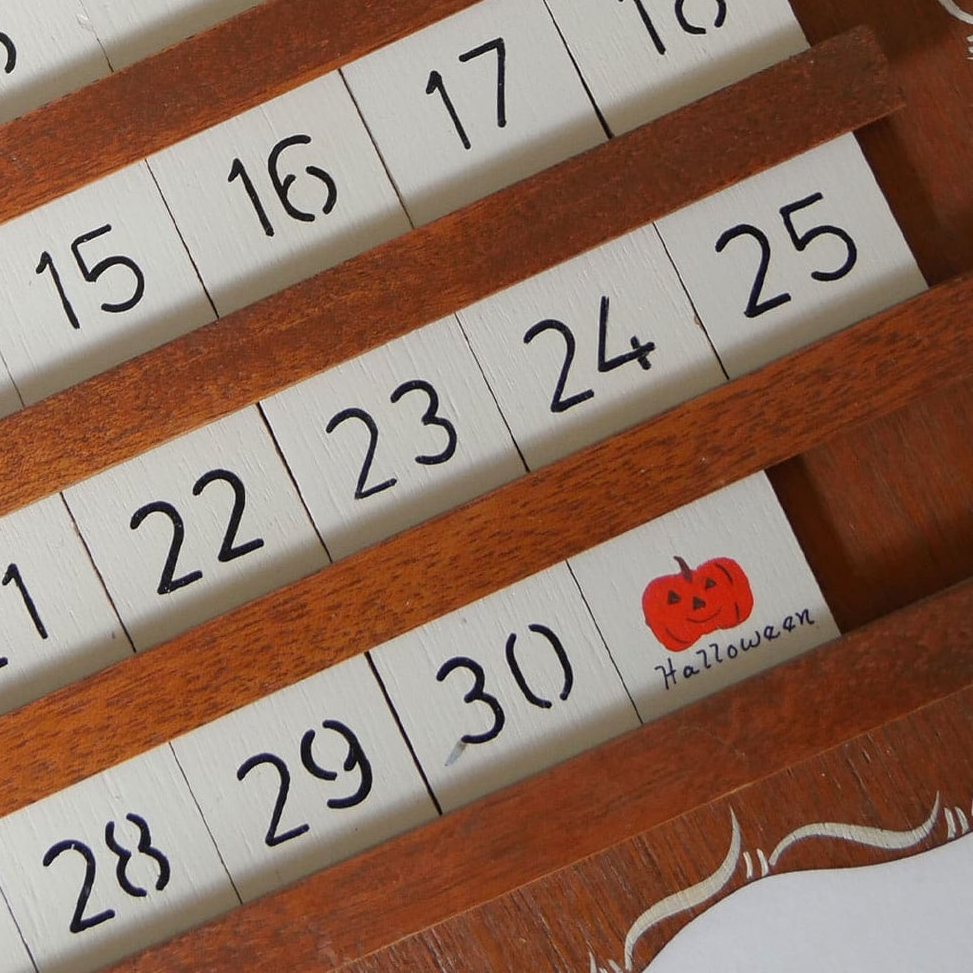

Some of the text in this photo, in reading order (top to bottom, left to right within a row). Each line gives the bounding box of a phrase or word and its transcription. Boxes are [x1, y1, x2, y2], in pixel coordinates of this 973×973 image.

[35, 224, 145, 330] 15
[227, 134, 338, 237] 16
[425, 37, 507, 150] 17
[130, 469, 265, 592] 22
[325, 379, 458, 500] 23
[524, 295, 655, 412] 24
[717, 193, 858, 319] 25
[43, 813, 170, 936] 28
[237, 719, 374, 847] 29
[439, 624, 574, 745] 30
[654, 608, 816, 690] Halloween
